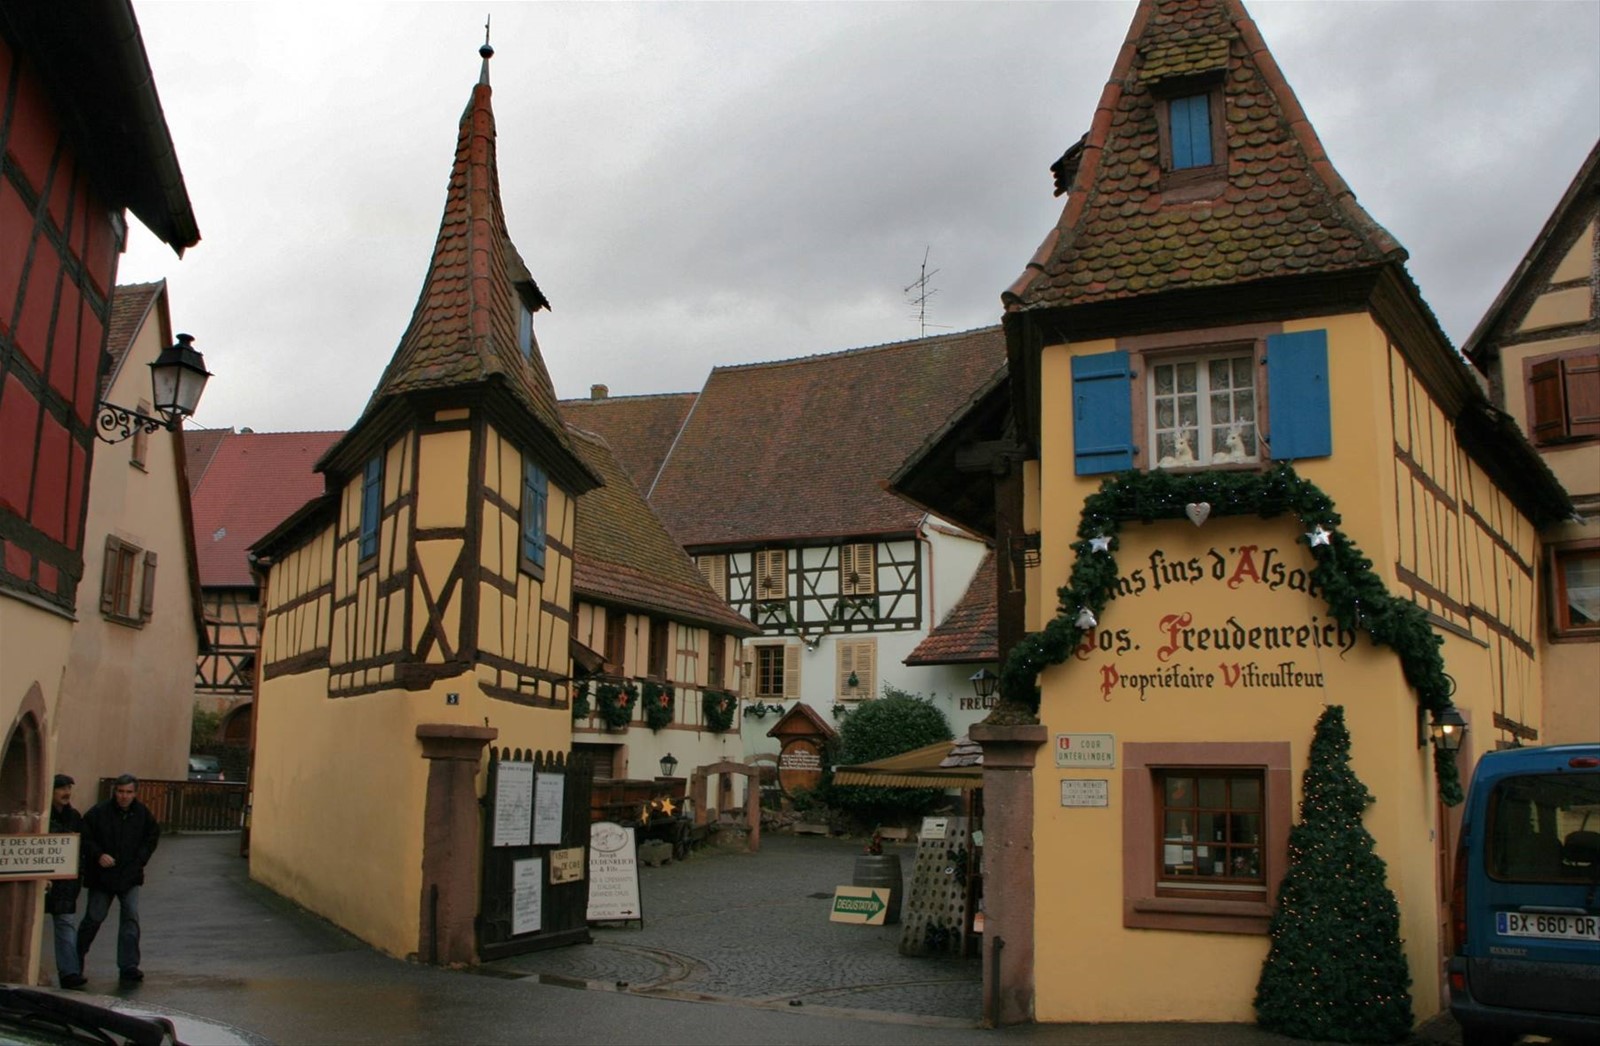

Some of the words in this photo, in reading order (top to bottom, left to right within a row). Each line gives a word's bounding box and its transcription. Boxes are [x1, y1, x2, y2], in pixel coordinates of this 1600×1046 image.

[1149, 549, 1204, 591] fins
[1207, 544, 1325, 598] d'Alsac
[1157, 611, 1356, 662] Freudenreich
[1100, 663, 1214, 702] Propriétaire
[1219, 661, 1324, 688] Viticulteur
[1080, 740, 1102, 749] COUR
[1058, 752, 1112, 761] UNTERLINDEN
[61, 837, 71, 845] ET
[3, 848, 14, 856] LA
[48, 847, 62, 855] DU
